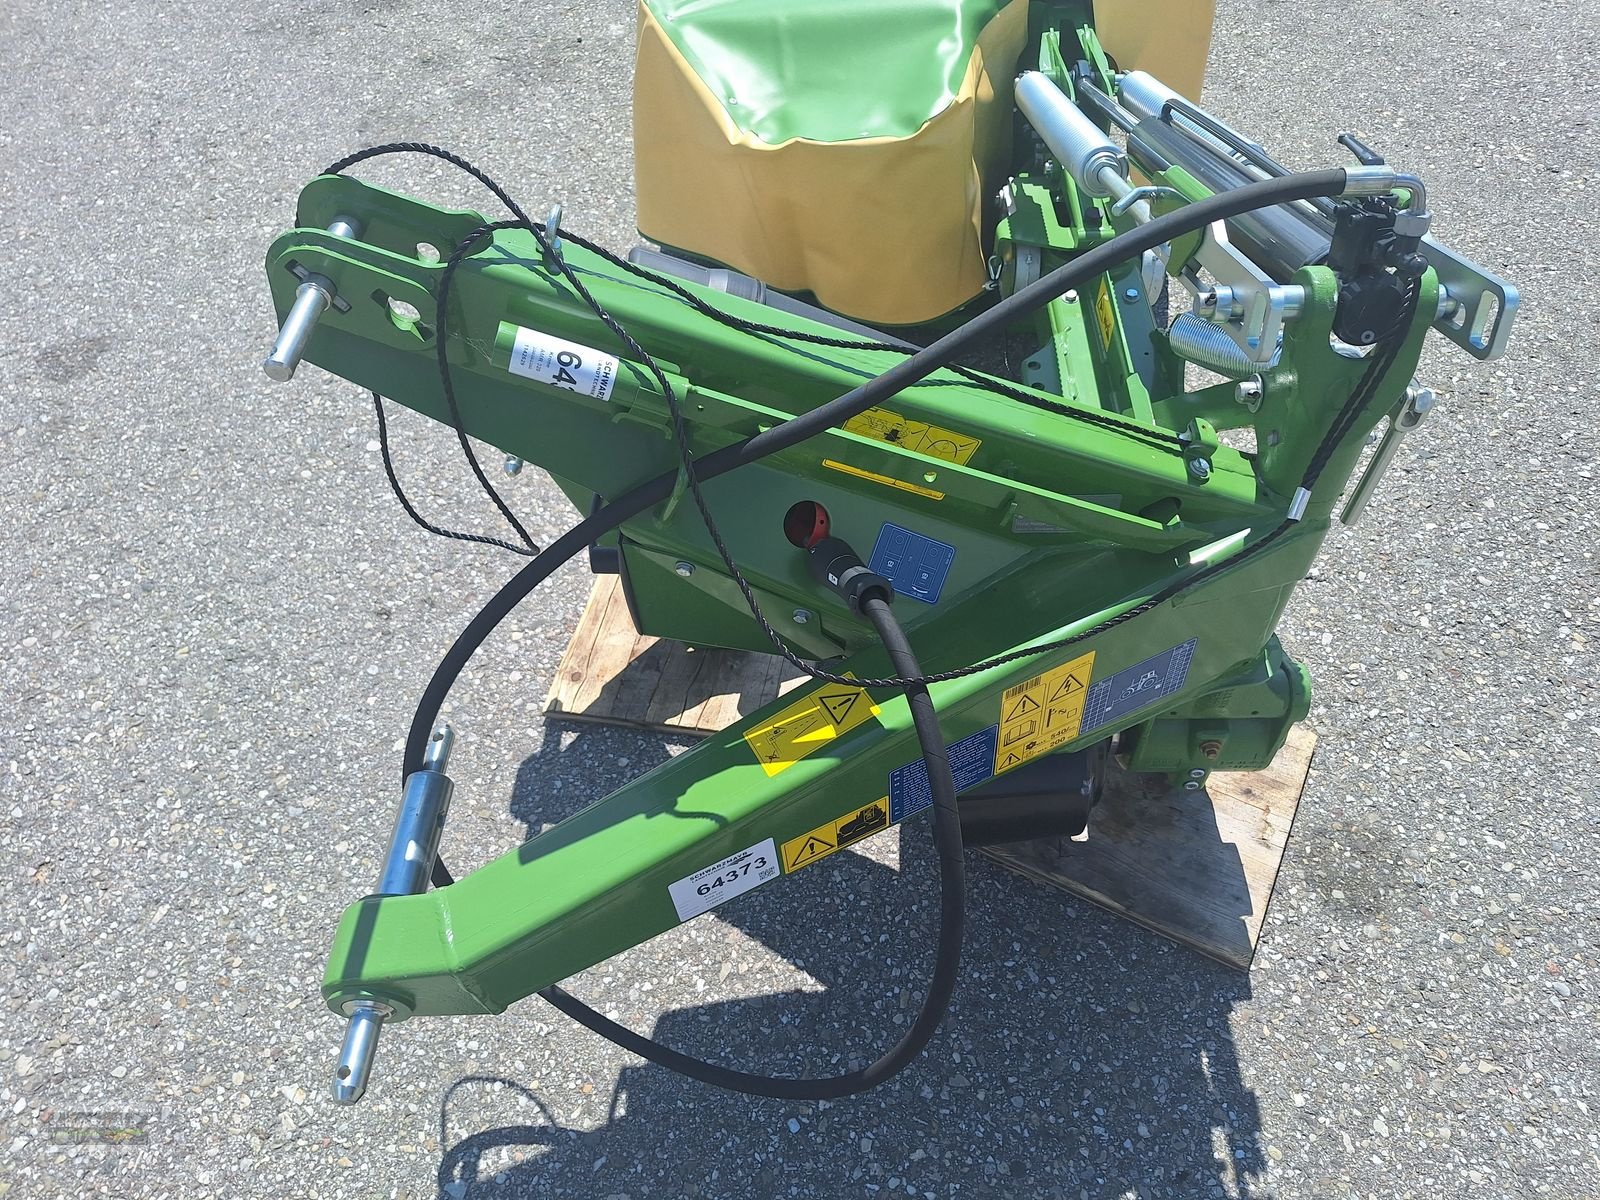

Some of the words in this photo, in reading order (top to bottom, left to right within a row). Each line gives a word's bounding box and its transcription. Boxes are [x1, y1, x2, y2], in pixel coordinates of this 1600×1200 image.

[597, 361, 612, 399] SCHWARZ
[690, 851, 748, 881] SCHWARZMAYR
[697, 856, 767, 896] 64373
